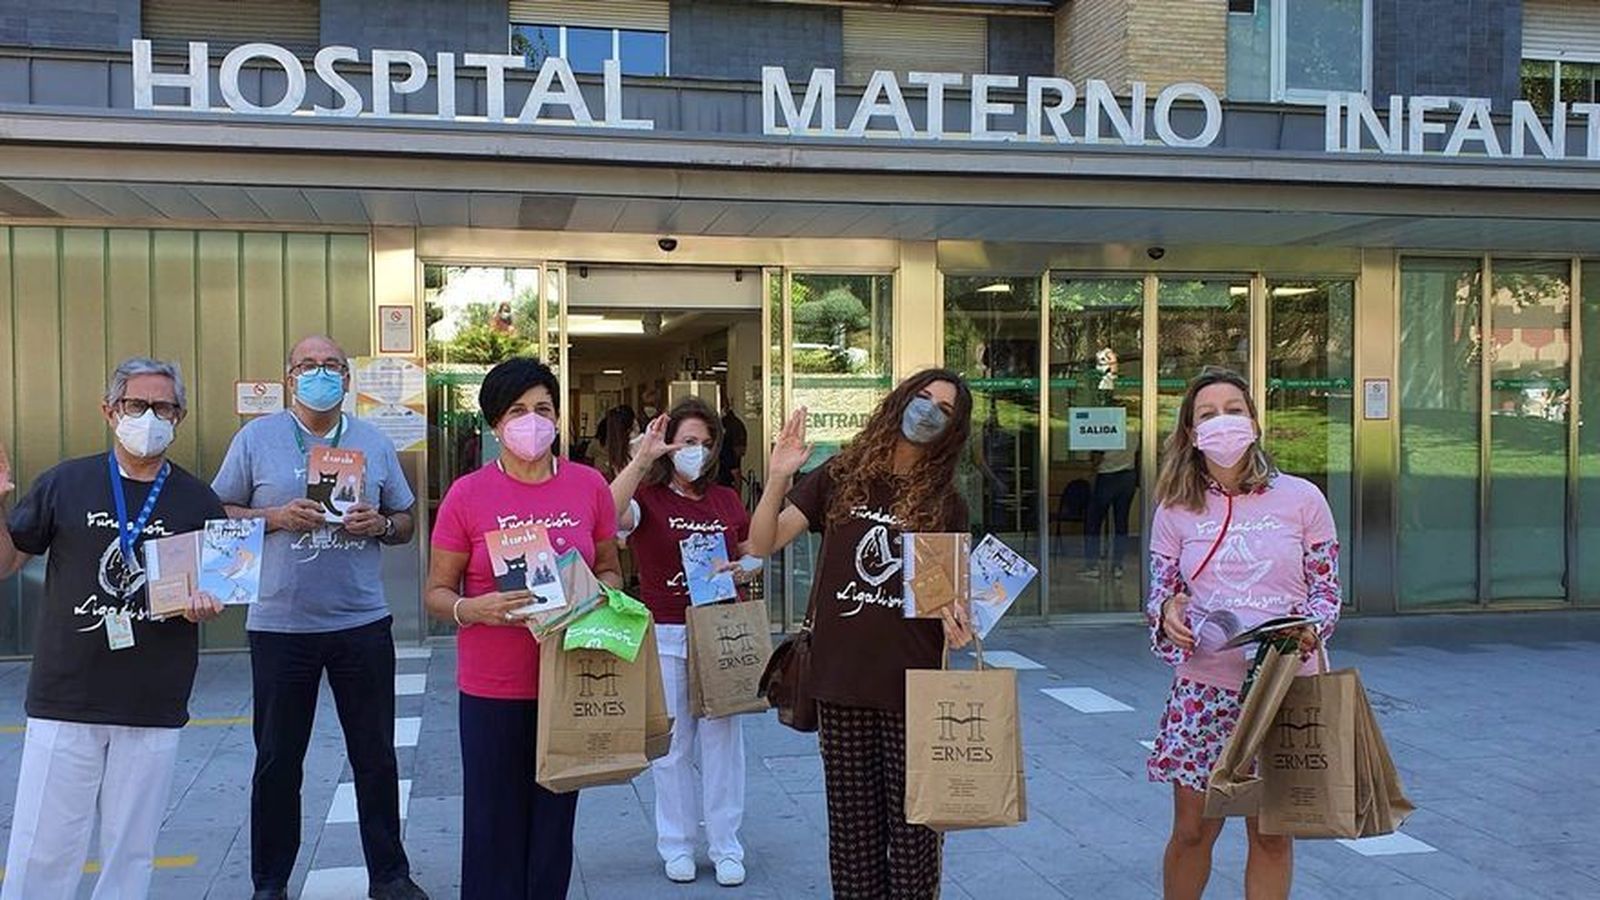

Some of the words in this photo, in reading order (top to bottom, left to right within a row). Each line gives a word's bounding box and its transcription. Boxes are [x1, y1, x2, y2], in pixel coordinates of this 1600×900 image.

[132, 39, 653, 129] HOSPITAL
[762, 66, 1222, 148] MATERNO
[1079, 425, 1118, 435] SALIDA
[573, 701, 626, 717] ERMES
[931, 745, 993, 762] ERMES
[1274, 753, 1328, 770] ERMES
